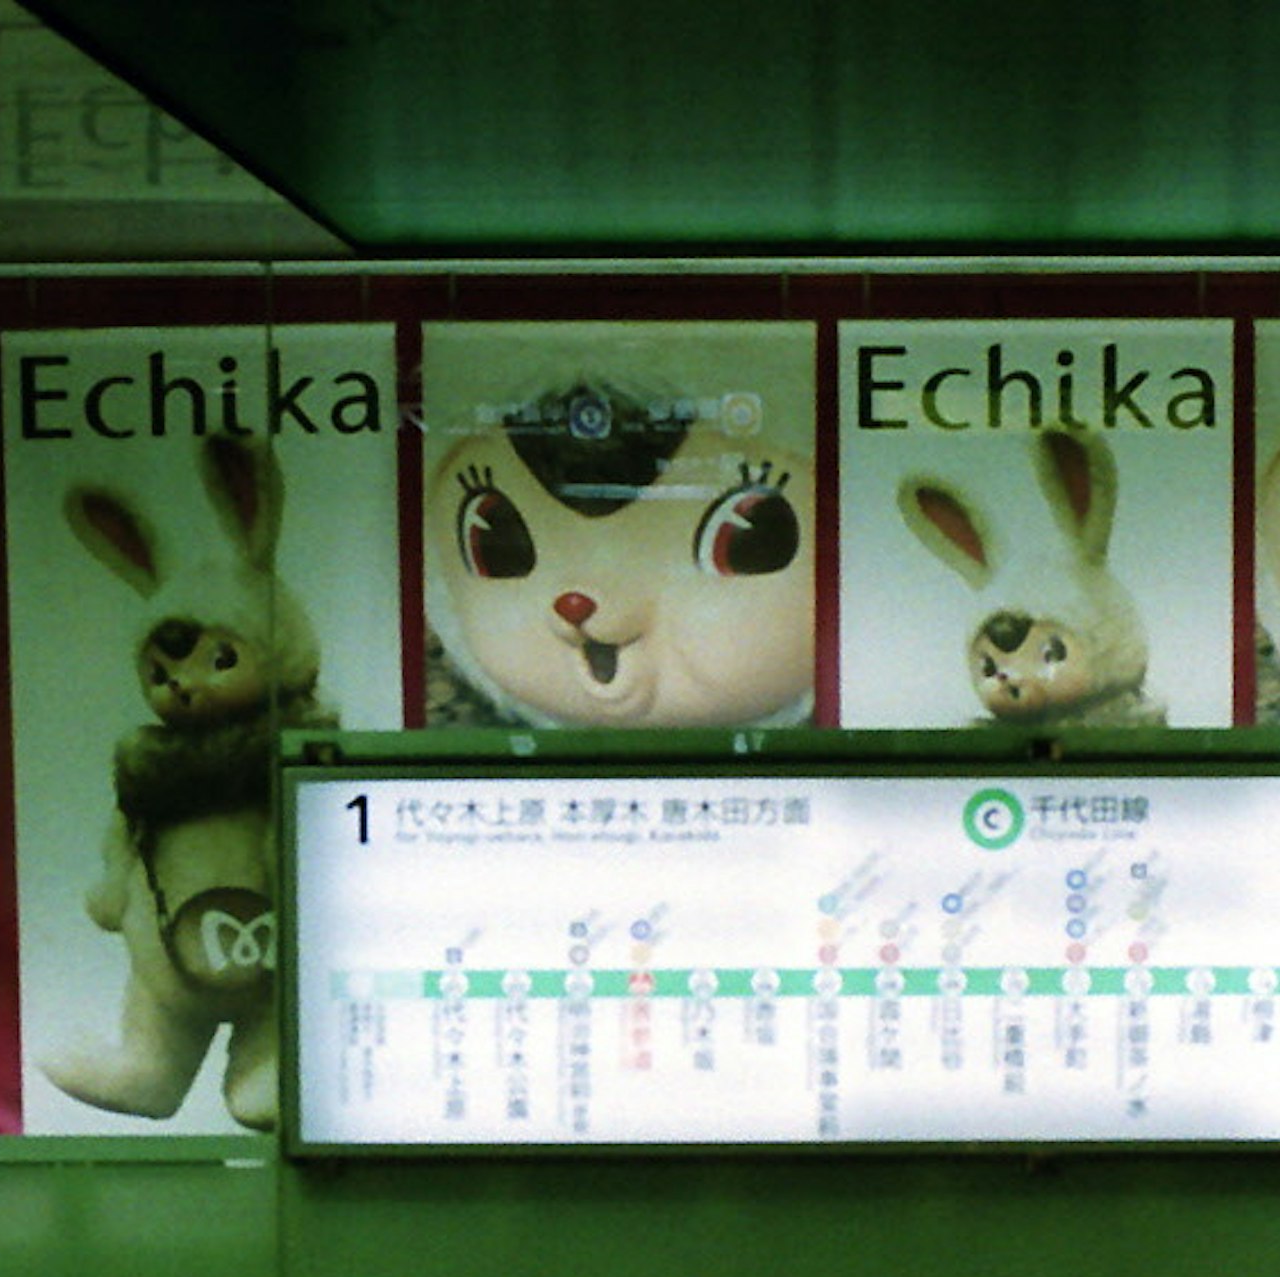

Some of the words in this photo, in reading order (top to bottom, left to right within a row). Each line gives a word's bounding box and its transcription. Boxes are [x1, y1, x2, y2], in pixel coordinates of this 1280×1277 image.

[20, 351, 382, 441] Echika
[855, 343, 1216, 430] Echika
[345, 793, 370, 846] 1
[982, 807, 1000, 830] C
[1030, 794, 1150, 824] 千代田線
